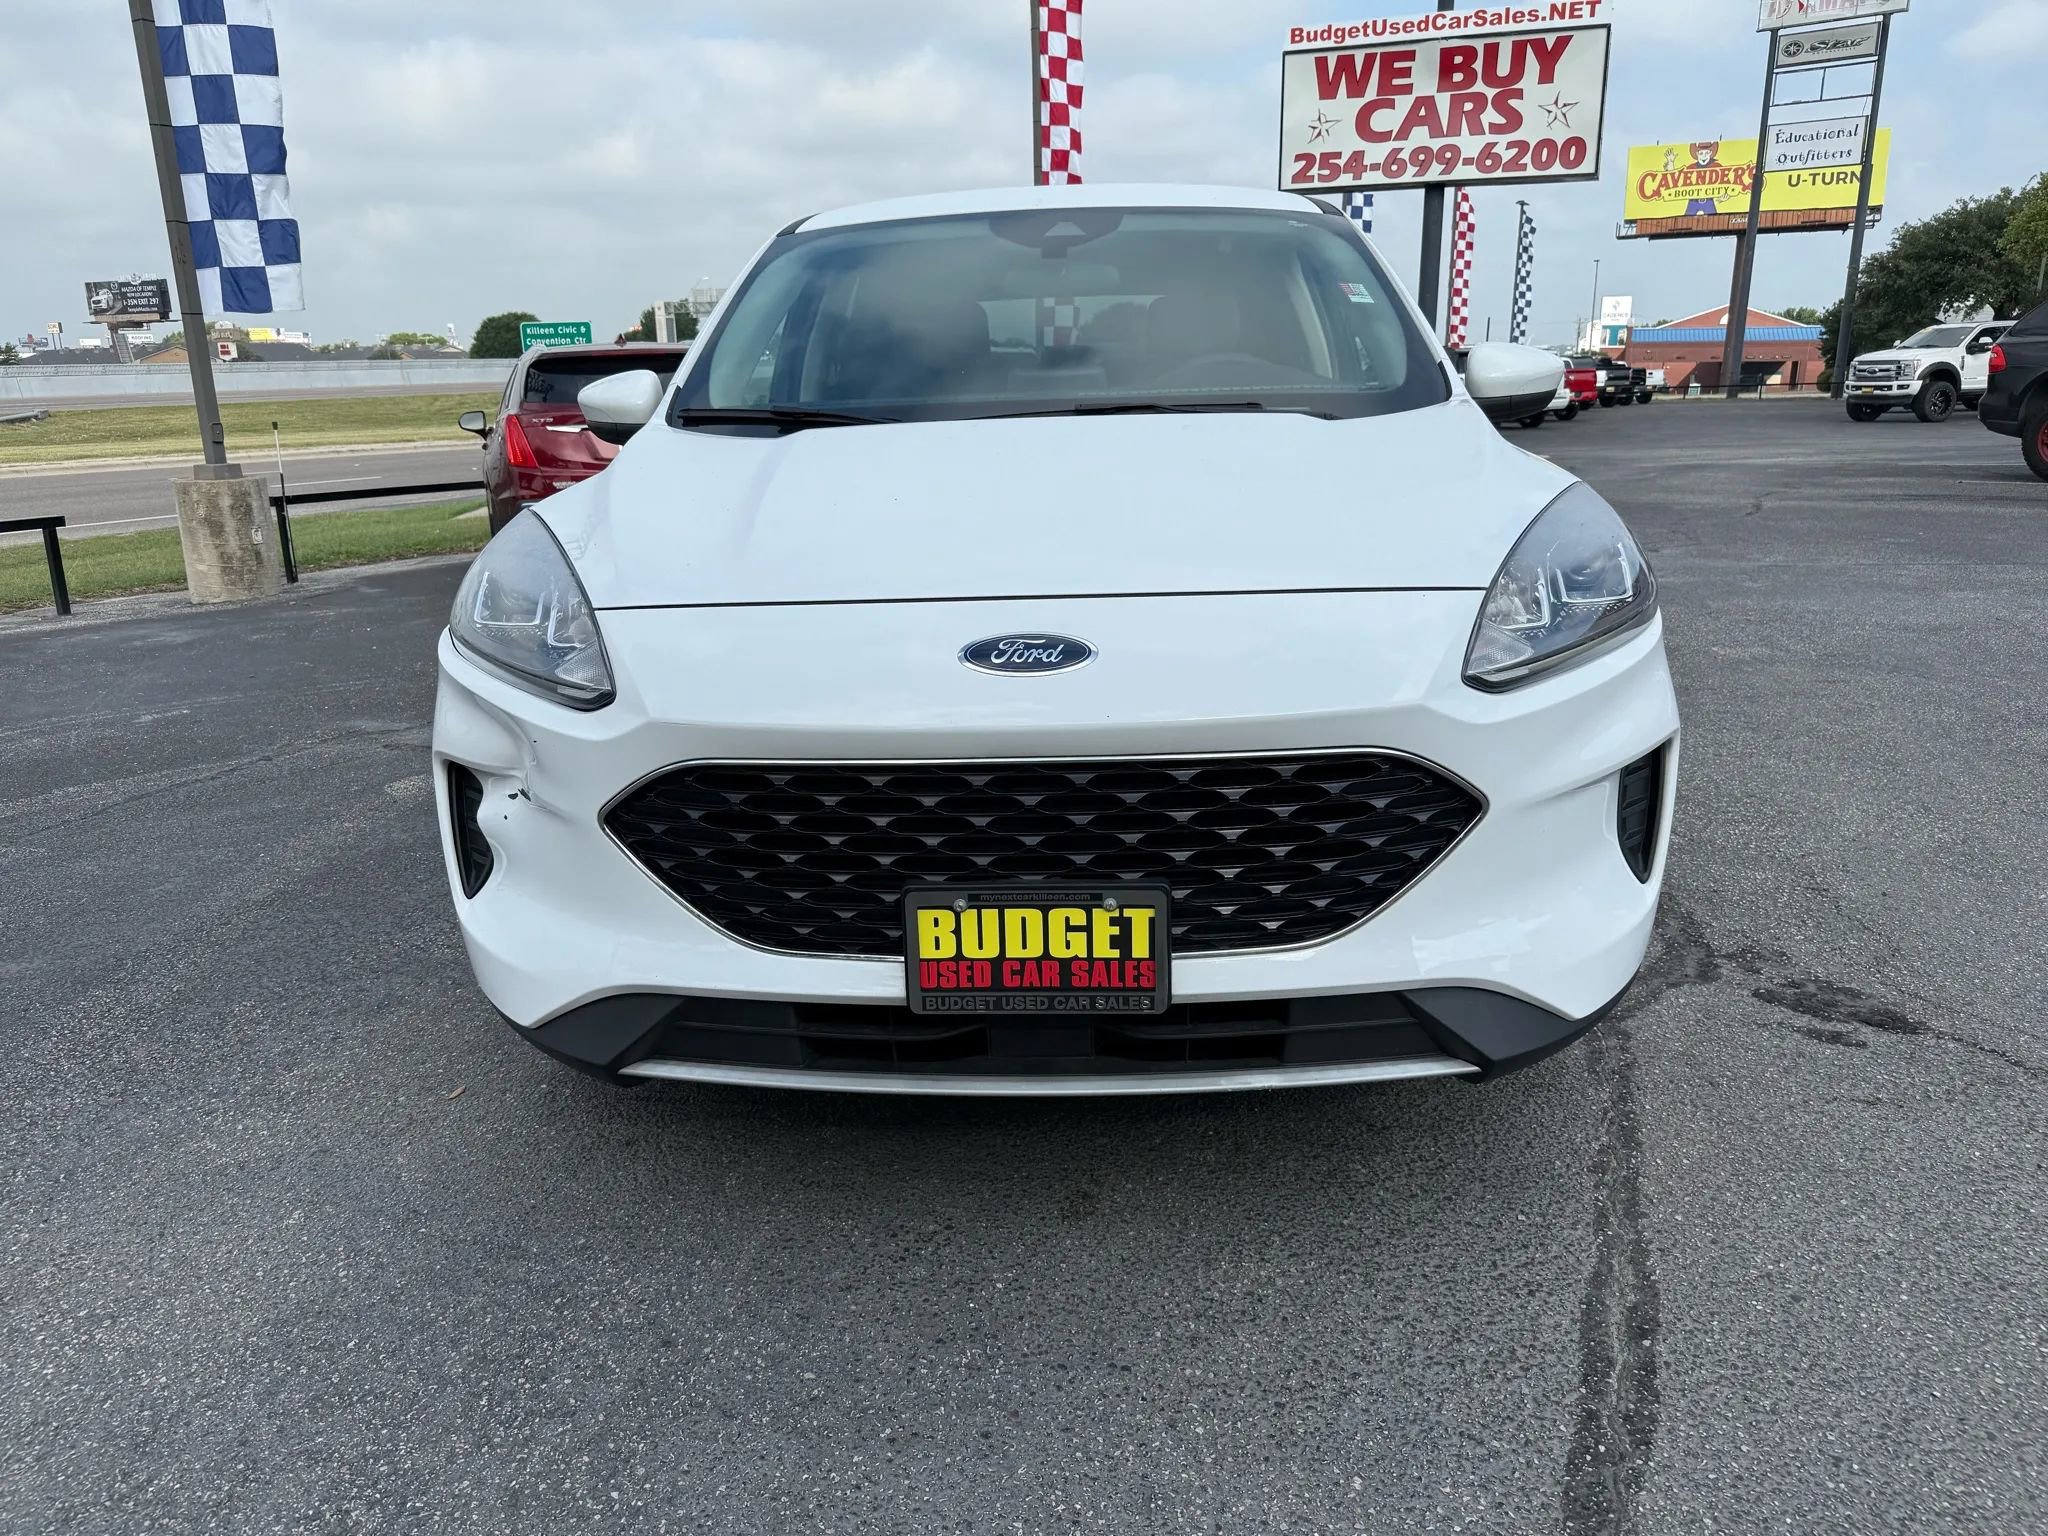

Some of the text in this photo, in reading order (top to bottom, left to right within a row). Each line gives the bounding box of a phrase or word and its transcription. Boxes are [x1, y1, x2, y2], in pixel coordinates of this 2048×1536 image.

[1290, 0, 1600, 44] BudgetUsedCarSales.NET
[1314, 35, 1574, 100] WE BUY
[1354, 88, 1524, 143] CARS
[1775, 124, 1859, 144] Educational
[1291, 136, 1587, 184] 254-699-6200
[1776, 149, 1853, 165] Outfitters
[1788, 170, 1860, 187] U-TURN
[1674, 186, 1730, 198] BOOT CITY
[526, 326, 555, 335] Killeen
[557, 325, 577, 334] Civic
[526, 336, 586, 345] Convention Ctr
[990, 639, 1064, 664] Ford
[917, 908, 1156, 959] BUDGET
[920, 960, 1156, 988] USED CAR SALES
[925, 996, 1151, 1011] BUDGET USED CAR SALES
